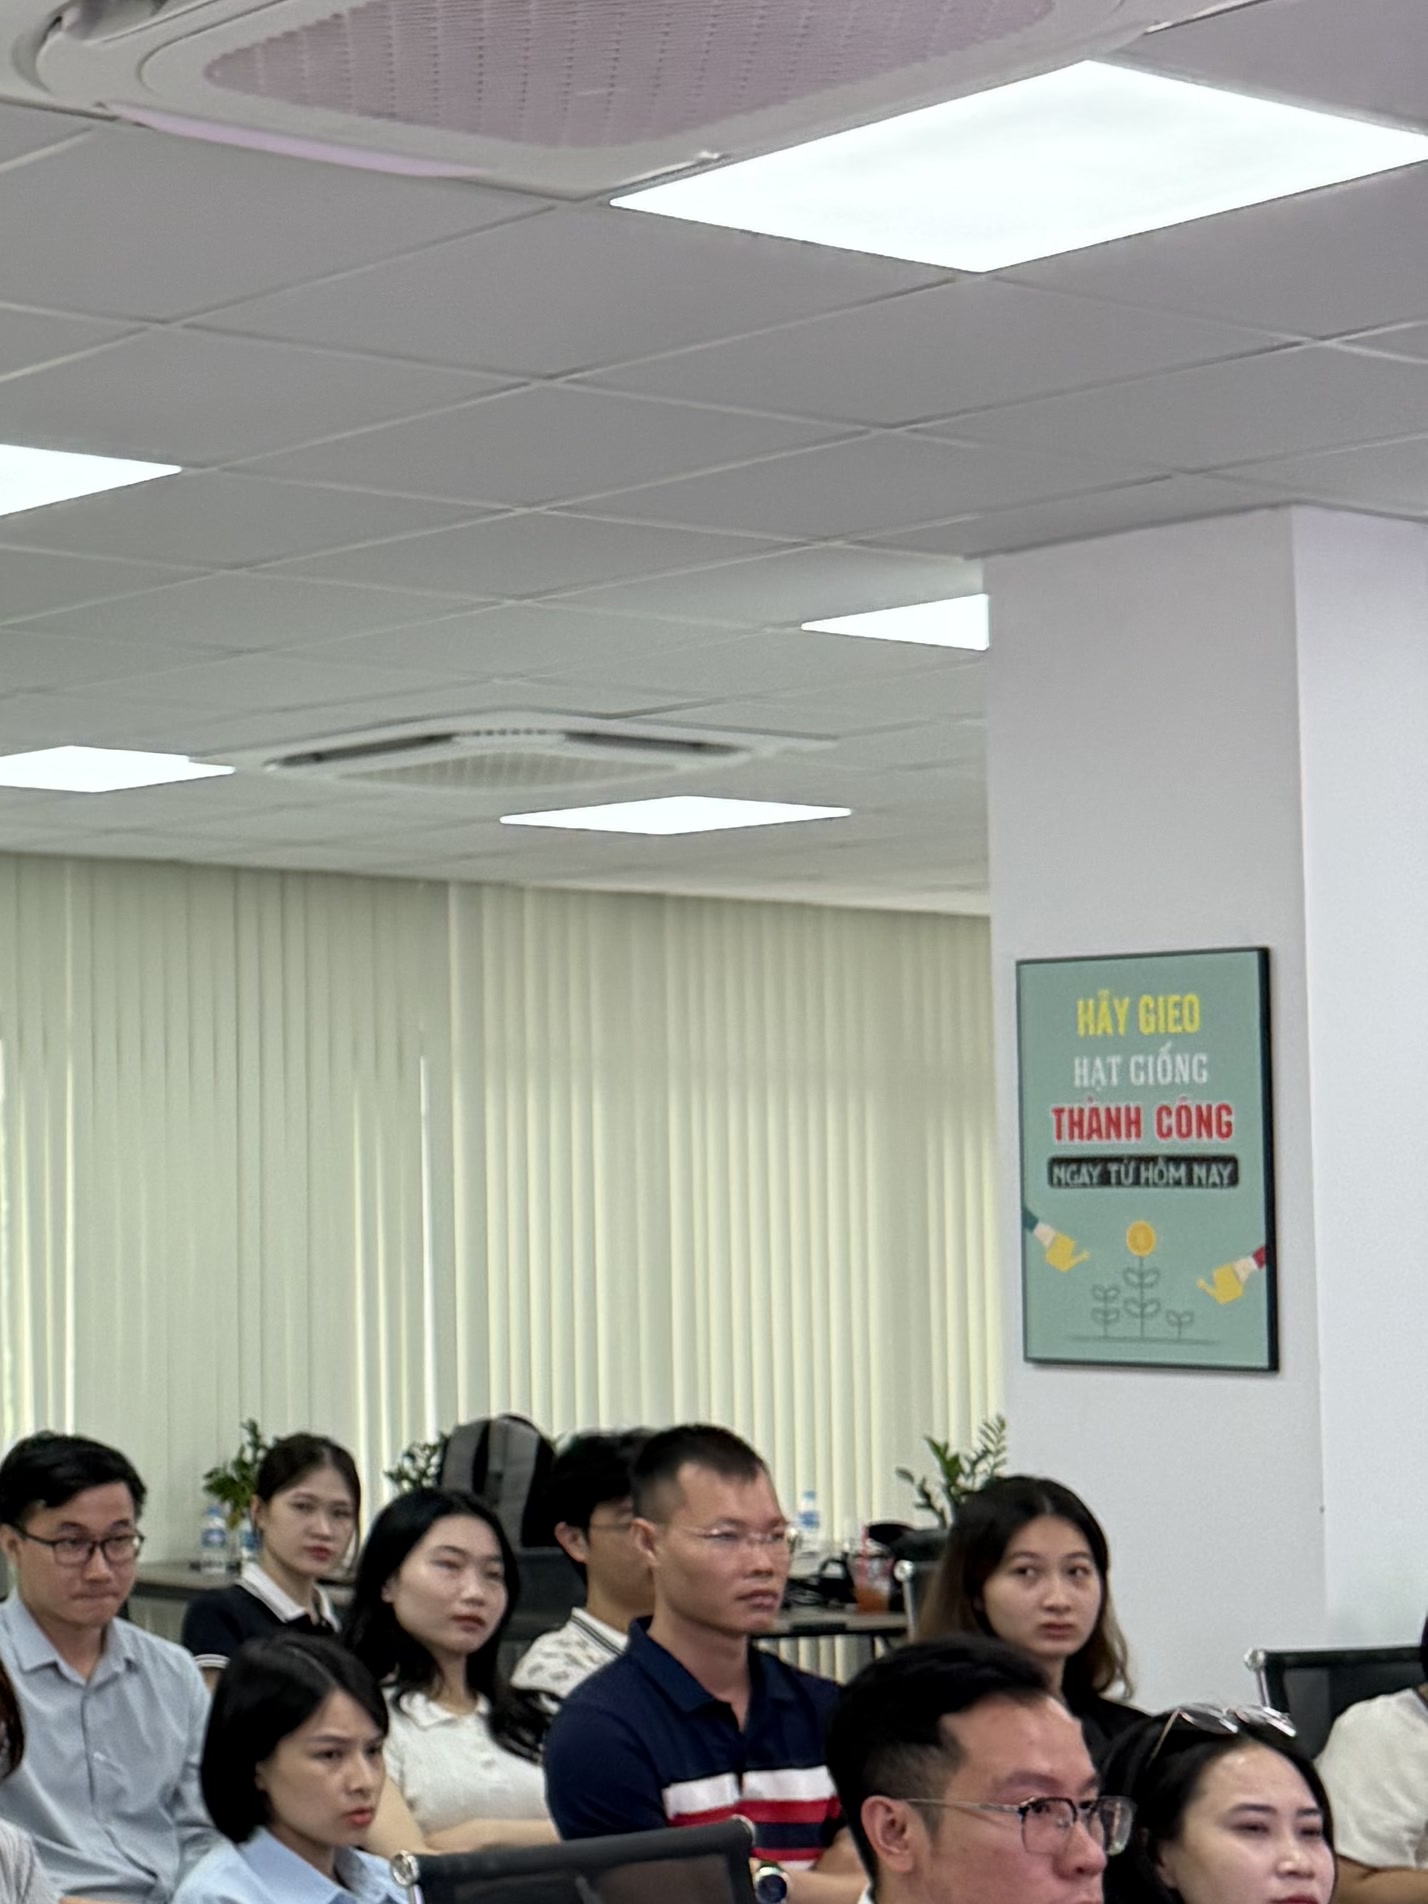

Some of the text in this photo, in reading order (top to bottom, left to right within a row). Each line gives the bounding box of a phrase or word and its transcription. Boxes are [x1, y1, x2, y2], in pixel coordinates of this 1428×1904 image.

[1137, 993, 1201, 1036] GIEO
[1073, 1041, 1209, 1092] HẠT GIỐNG
[1154, 1095, 1234, 1140] CÔNG
[1051, 1161, 1102, 1186] NGAY
[1140, 1156, 1187, 1186] HÔM
[1192, 1161, 1233, 1186] NAY
